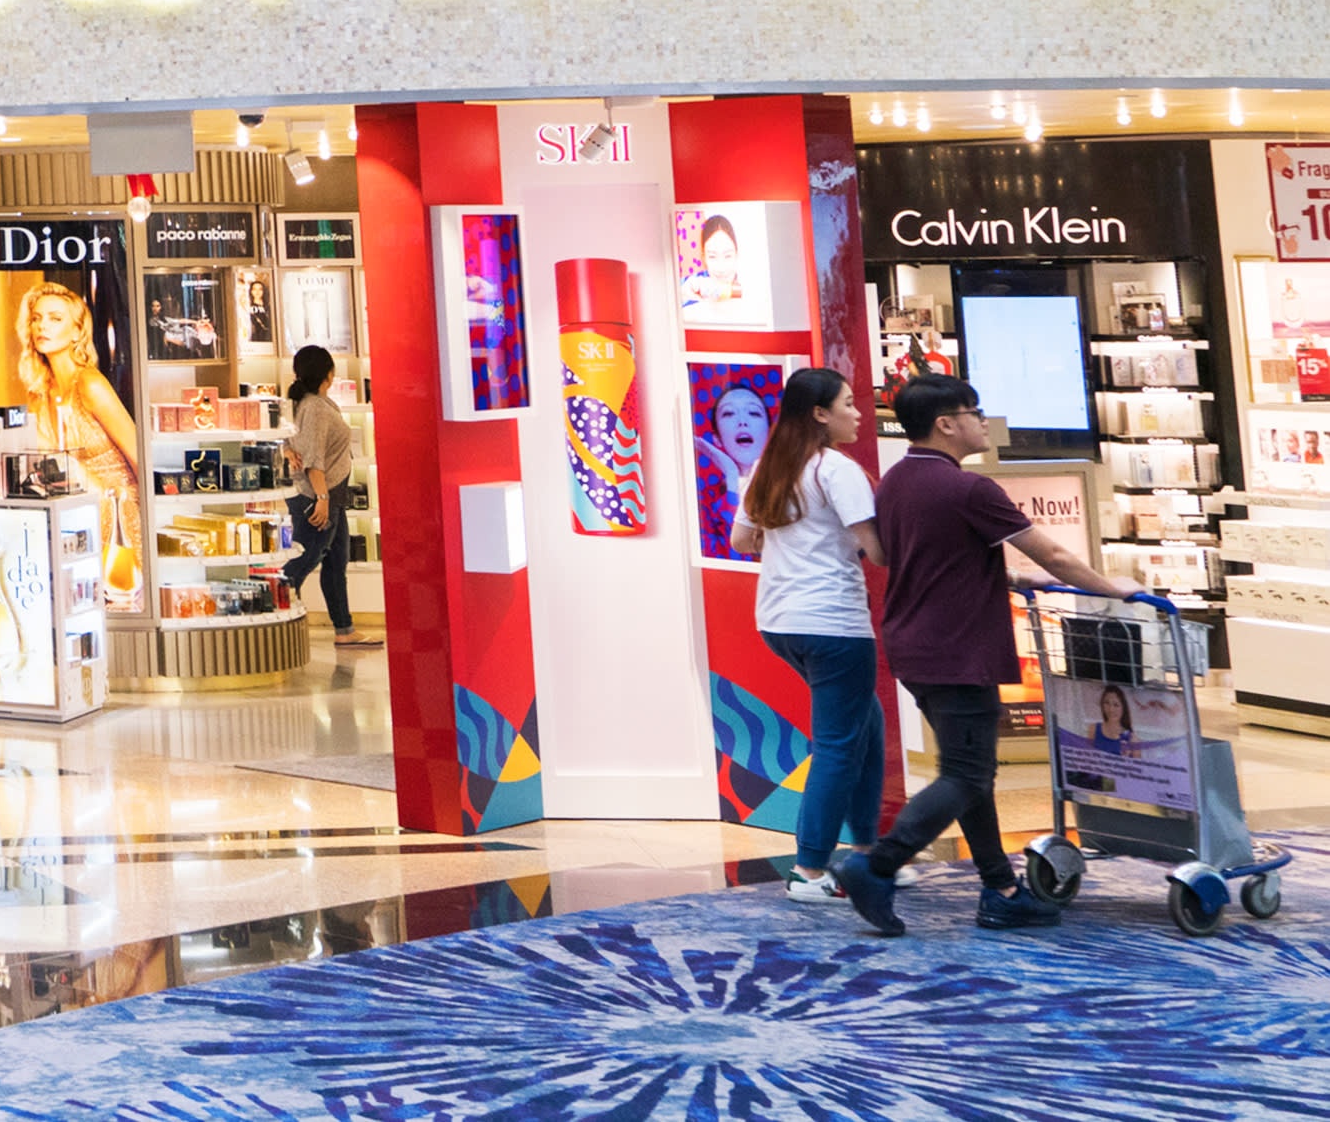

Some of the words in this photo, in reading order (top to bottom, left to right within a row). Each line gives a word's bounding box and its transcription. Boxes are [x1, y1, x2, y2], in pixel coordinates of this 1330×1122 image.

[538, 124, 631, 163] SKII
[156, 229, 196, 243] paco
[197, 225, 247, 242] rabanne
[891, 208, 1015, 247] Calvin
[1023, 206, 1127, 245] Klein
[0, 225, 112, 266] Dior
[1298, 358, 1329, 375] 15%
[8, 408, 26, 427] Dior
[882, 421, 906, 434] ISS
[1031, 495, 1081, 516] Now!
